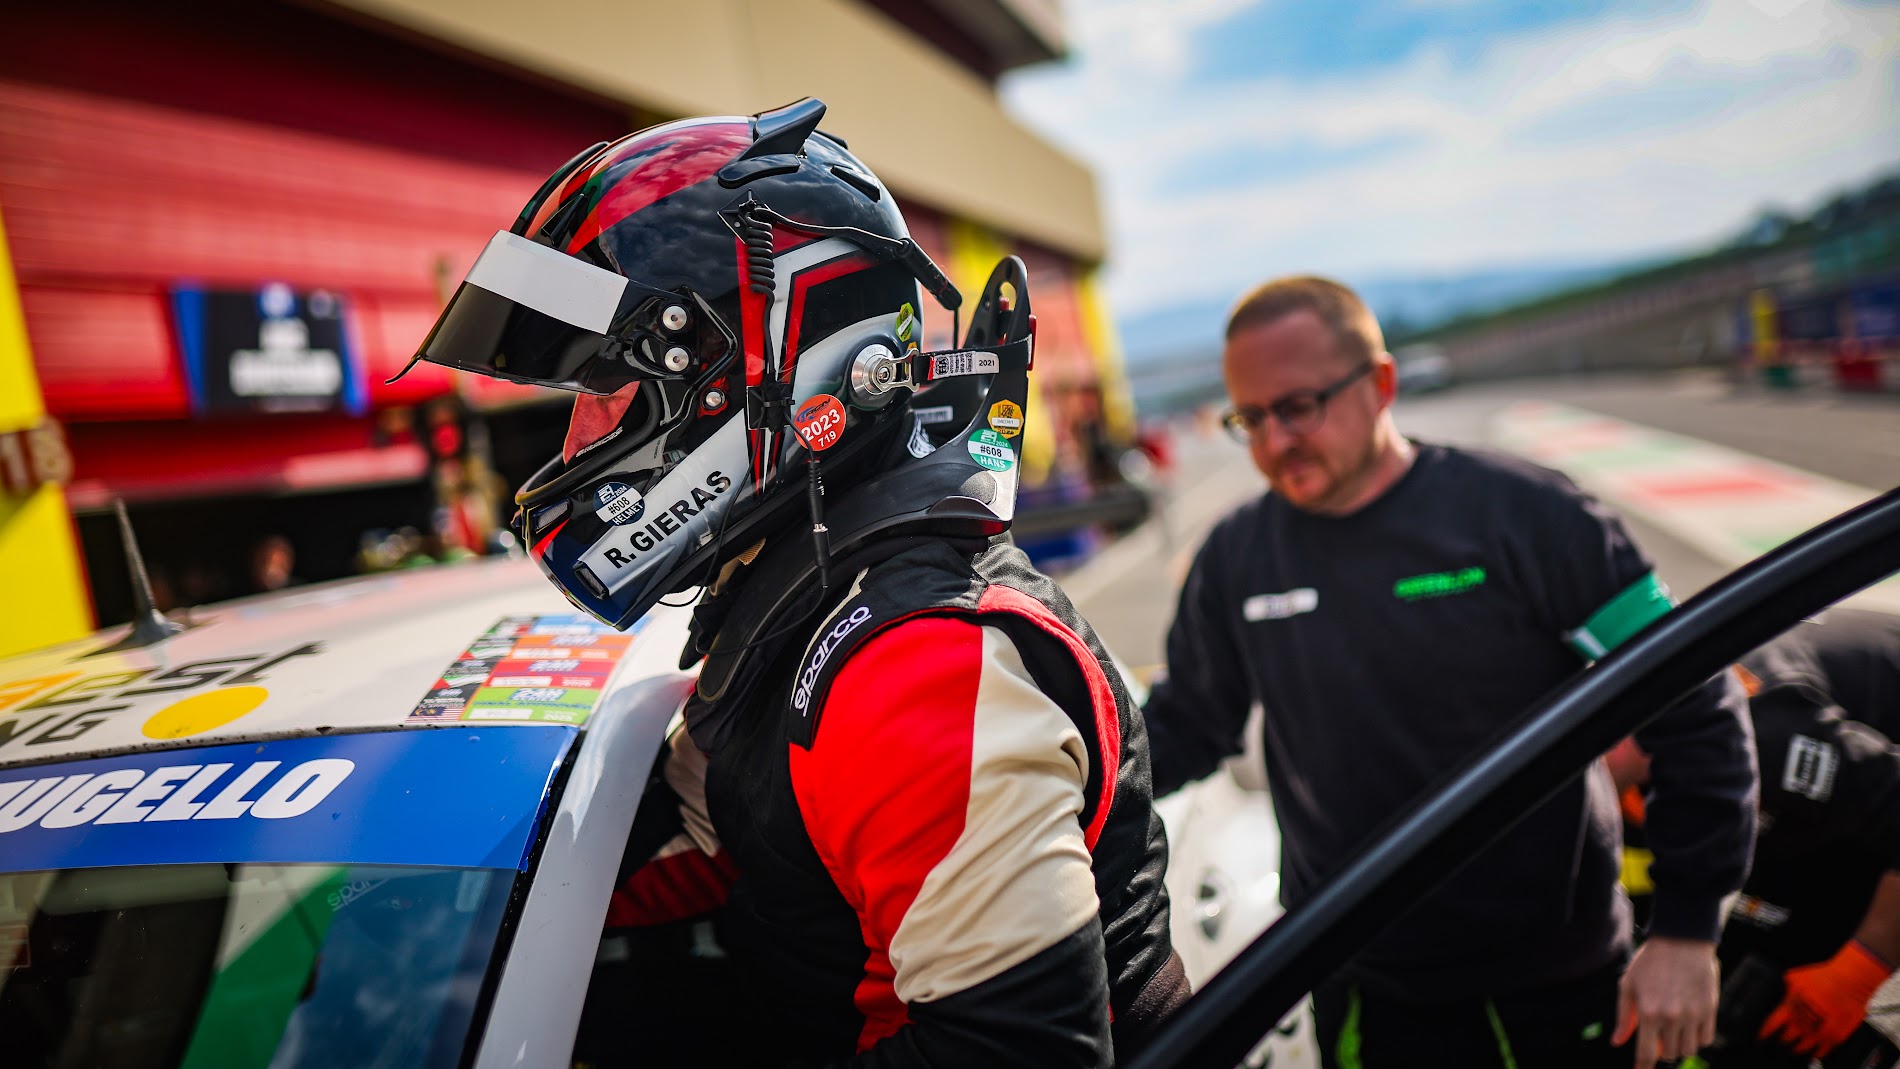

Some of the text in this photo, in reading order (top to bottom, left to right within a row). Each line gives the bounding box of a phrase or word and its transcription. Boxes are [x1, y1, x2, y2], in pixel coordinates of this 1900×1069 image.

[979, 359, 995, 367] 2021
[801, 409, 841, 442] 2023
[818, 430, 837, 447] 719
[980, 445, 1002, 458] #608
[980, 456, 1006, 469] HANS
[608, 497, 630, 515] #608
[612, 502, 644, 526] HELMET
[603, 470, 731, 569] R. GIERAS
[795, 606, 872, 717] sparco
